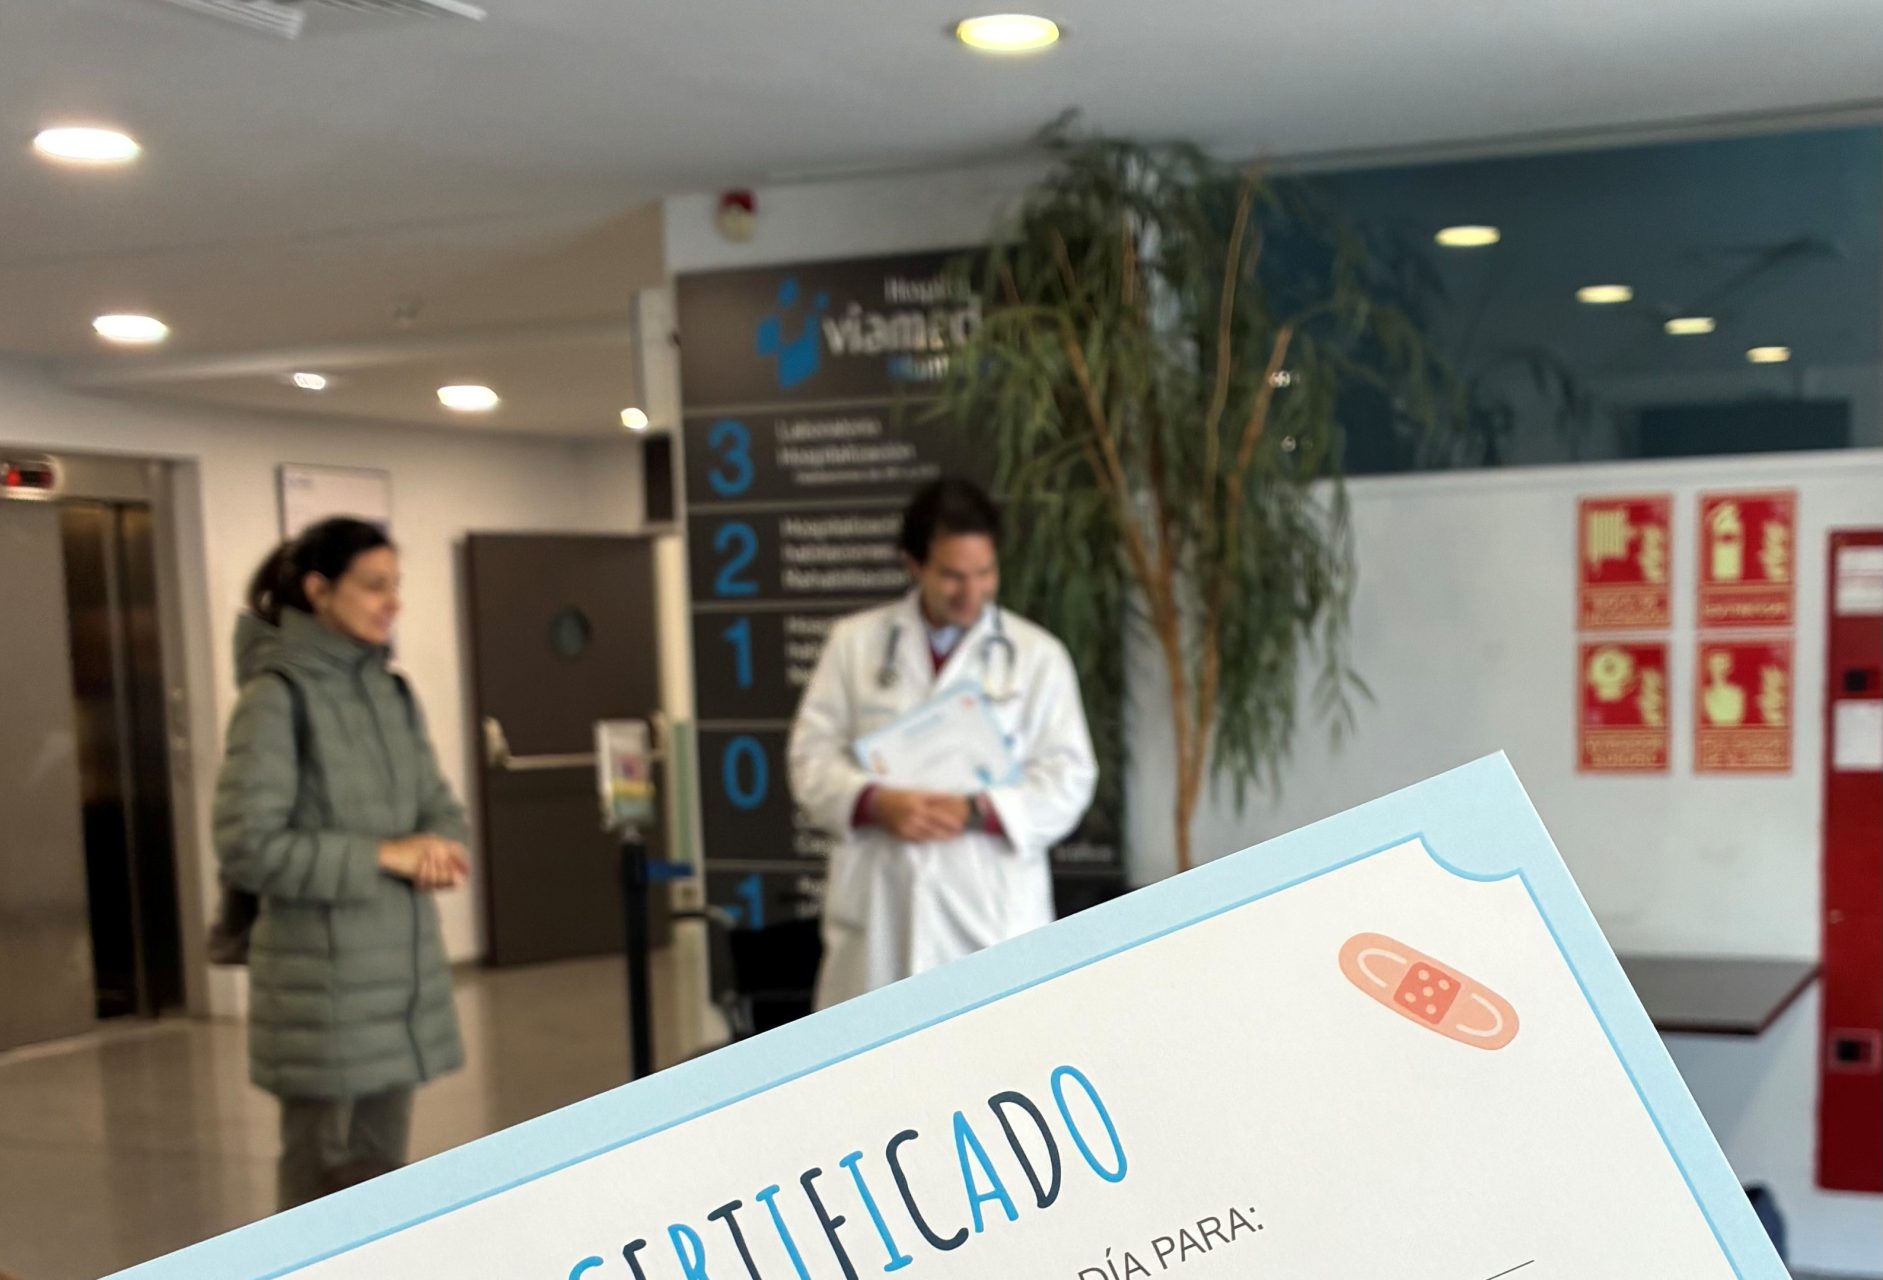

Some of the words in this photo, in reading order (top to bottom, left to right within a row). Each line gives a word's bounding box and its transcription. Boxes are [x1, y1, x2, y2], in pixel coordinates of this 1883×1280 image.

[707, 420, 755, 495] 3
[713, 522, 759, 596] 2
[723, 619, 753, 688] 1
[722, 736, 769, 810] 0
[1150, 1205, 1265, 1270] PARA:
